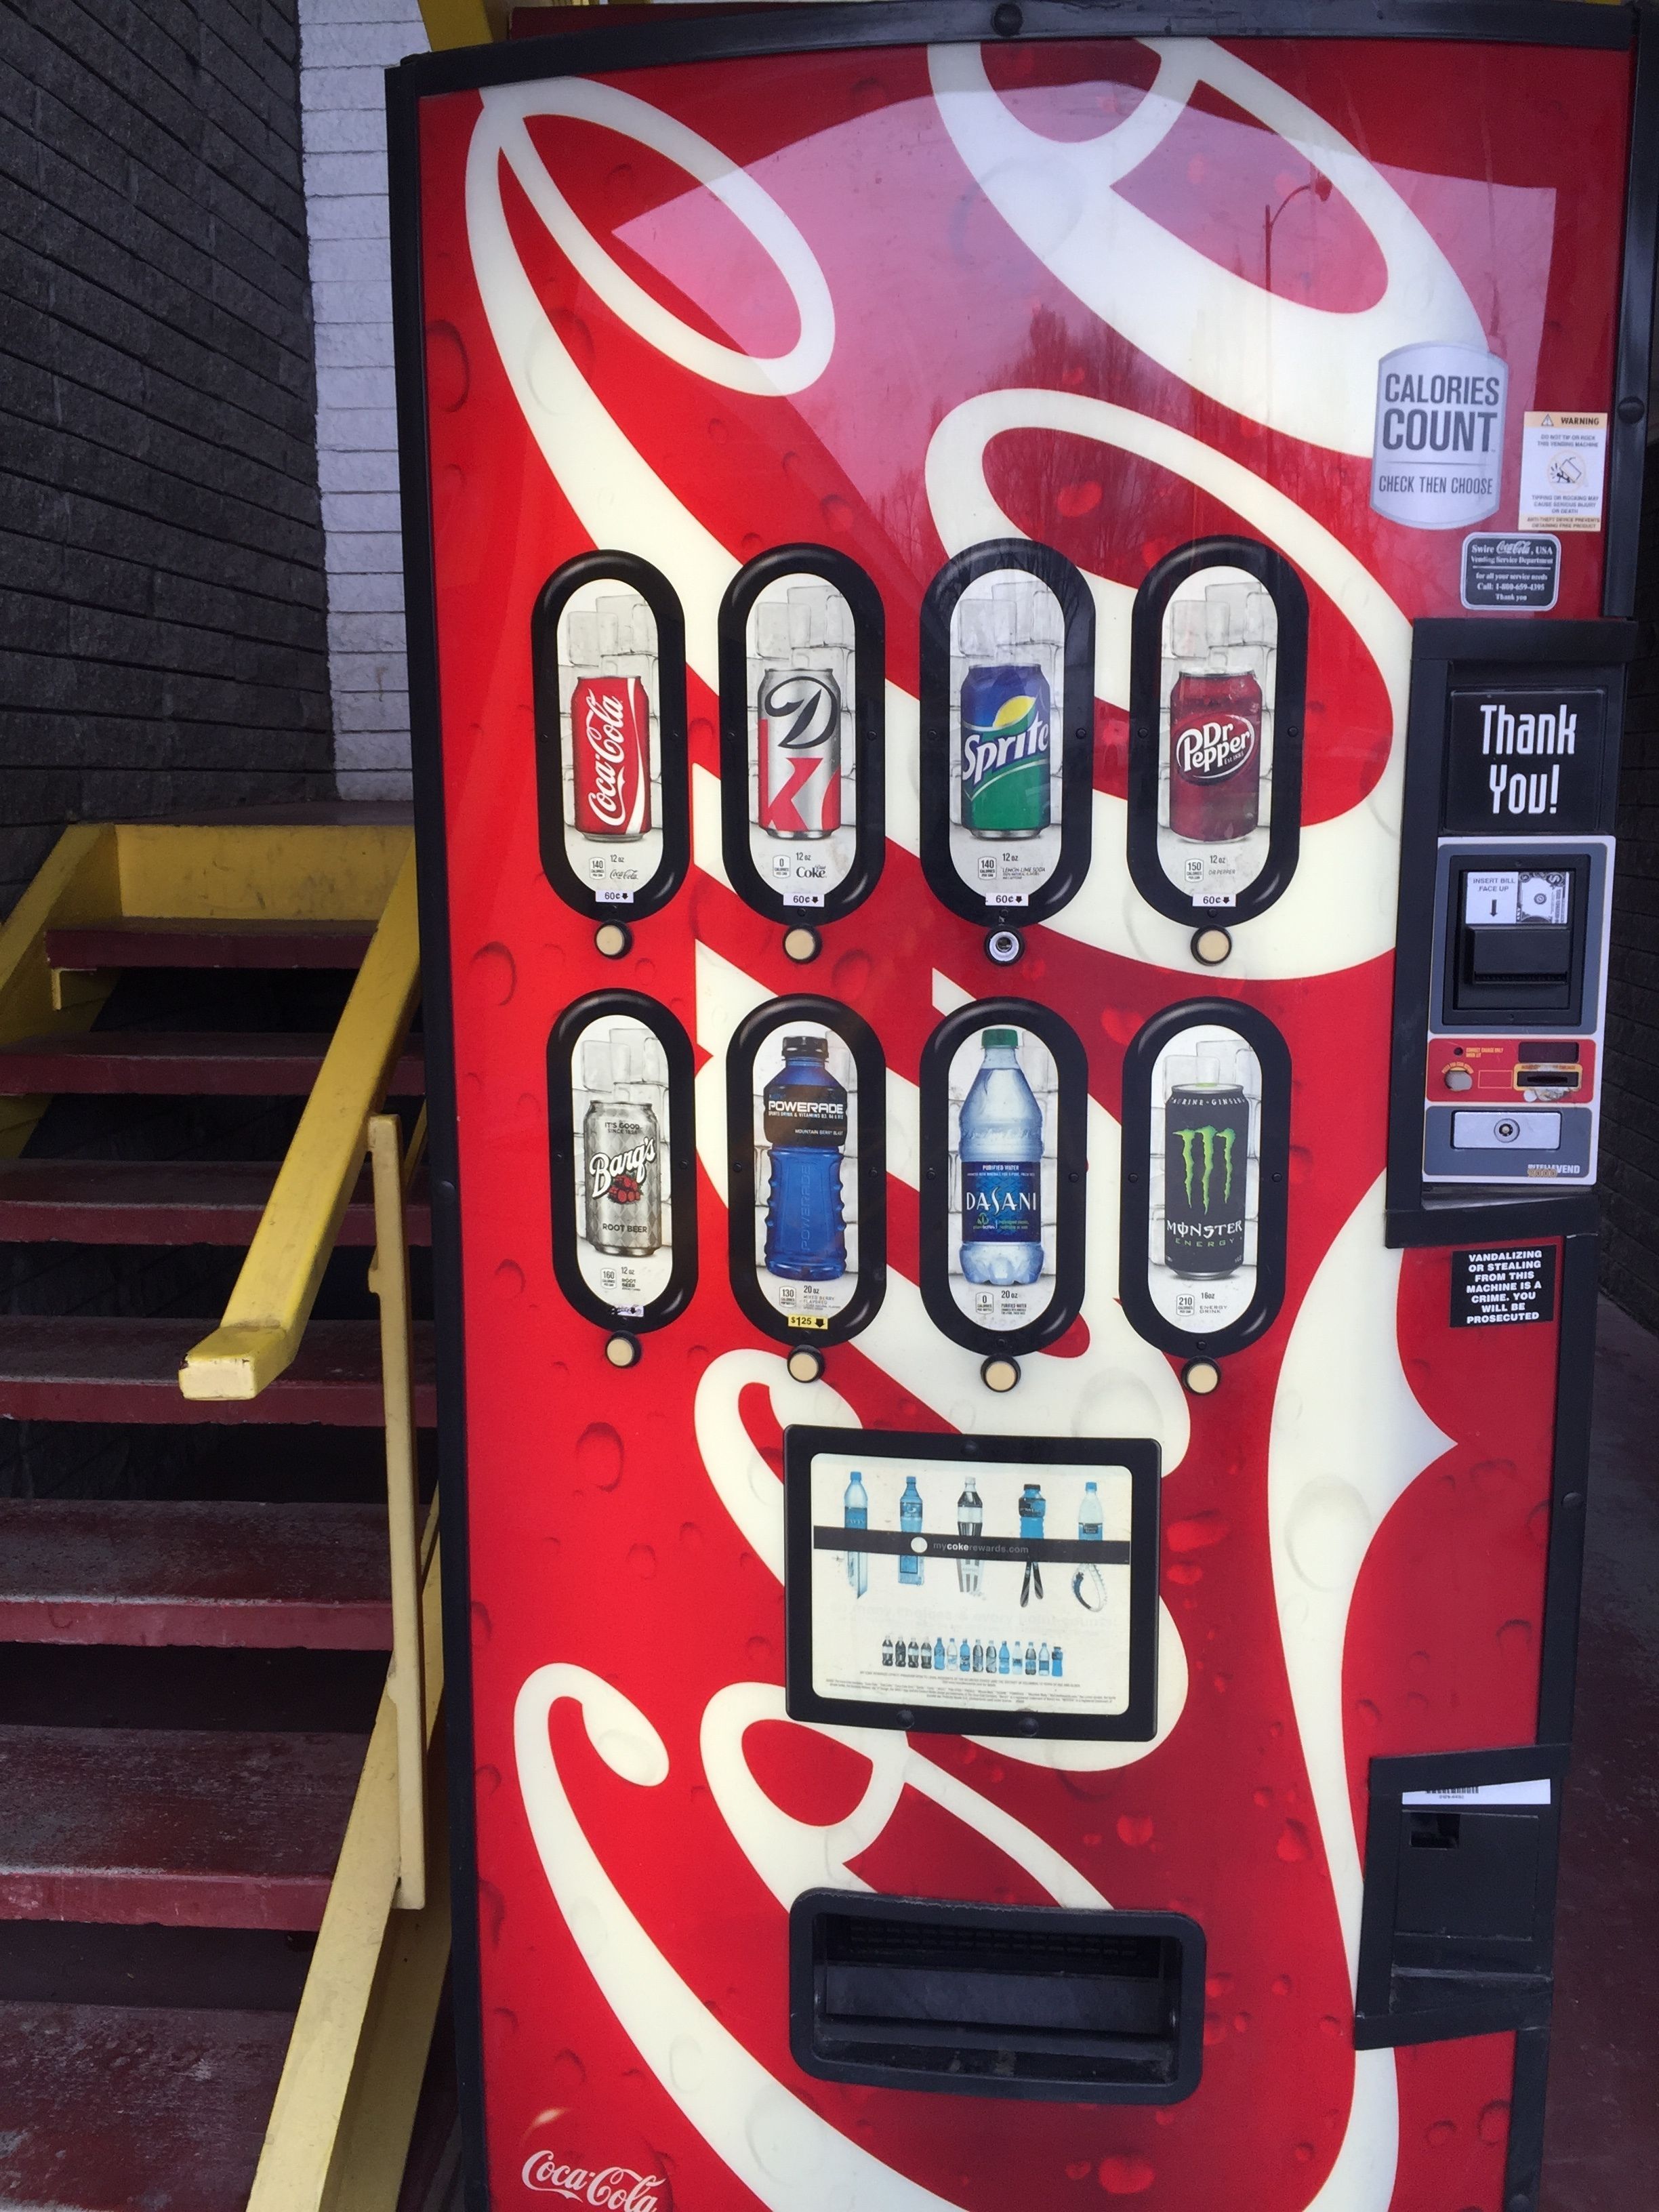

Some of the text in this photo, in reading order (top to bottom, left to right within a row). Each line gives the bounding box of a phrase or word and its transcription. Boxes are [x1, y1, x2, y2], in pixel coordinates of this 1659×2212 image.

[1385, 373, 1500, 406] CALORIES
[1383, 408, 1498, 452] COUNT
[1379, 475, 1493, 495] CHECK THEN CHOOSE
[1471, 545, 1494, 553] Swire
[1536, 546, 1553, 554] USA
[1471, 556, 1495, 564] Vending
[1519, 556, 1553, 565] Department
[1480, 704, 1577, 754] Thank
[1203, 722, 1233, 748] Dr
[962, 712, 1048, 785] Sprite
[1176, 729, 1250, 773] Pepper
[1489, 764, 1559, 814] You!
[610, 854, 617, 862] 12
[796, 852, 803, 861] 12
[1002, 853, 1010, 861] 12
[1210, 855, 1217, 863] 12
[779, 858, 783, 867] 0
[981, 860, 994, 868] 140
[1188, 862, 1201, 870] 150
[796, 866, 825, 878] Coke
[769, 1101, 843, 1113] POWERADE
[589, 1136, 656, 1200] Barq's
[966, 1187, 1036, 1216] DASANI
[602, 1223, 625, 1231] ROOT
[1167, 1220, 1242, 1238] MONSTER
[1175, 1237, 1234, 1247] ENERGY
[1469, 1250, 1542, 1262] VANDALIZING
[1488, 1261, 1541, 1271] STEALING
[603, 1271, 614, 1279] 160
[1475, 1271, 1534, 1282] FROM THIS
[1467, 1281, 1542, 1293] MACHINE IS A
[783, 1289, 794, 1297] 130
[1471, 1292, 1536, 1303] CRIME. YOU
[983, 1295, 987, 1303] 0
[1179, 1297, 1192, 1305] 210
[1481, 1304, 1507, 1313] WILL
[1467, 1312, 1539, 1324] PROSECUTED
[933, 1542, 1029, 1553] mycokerewards.com
